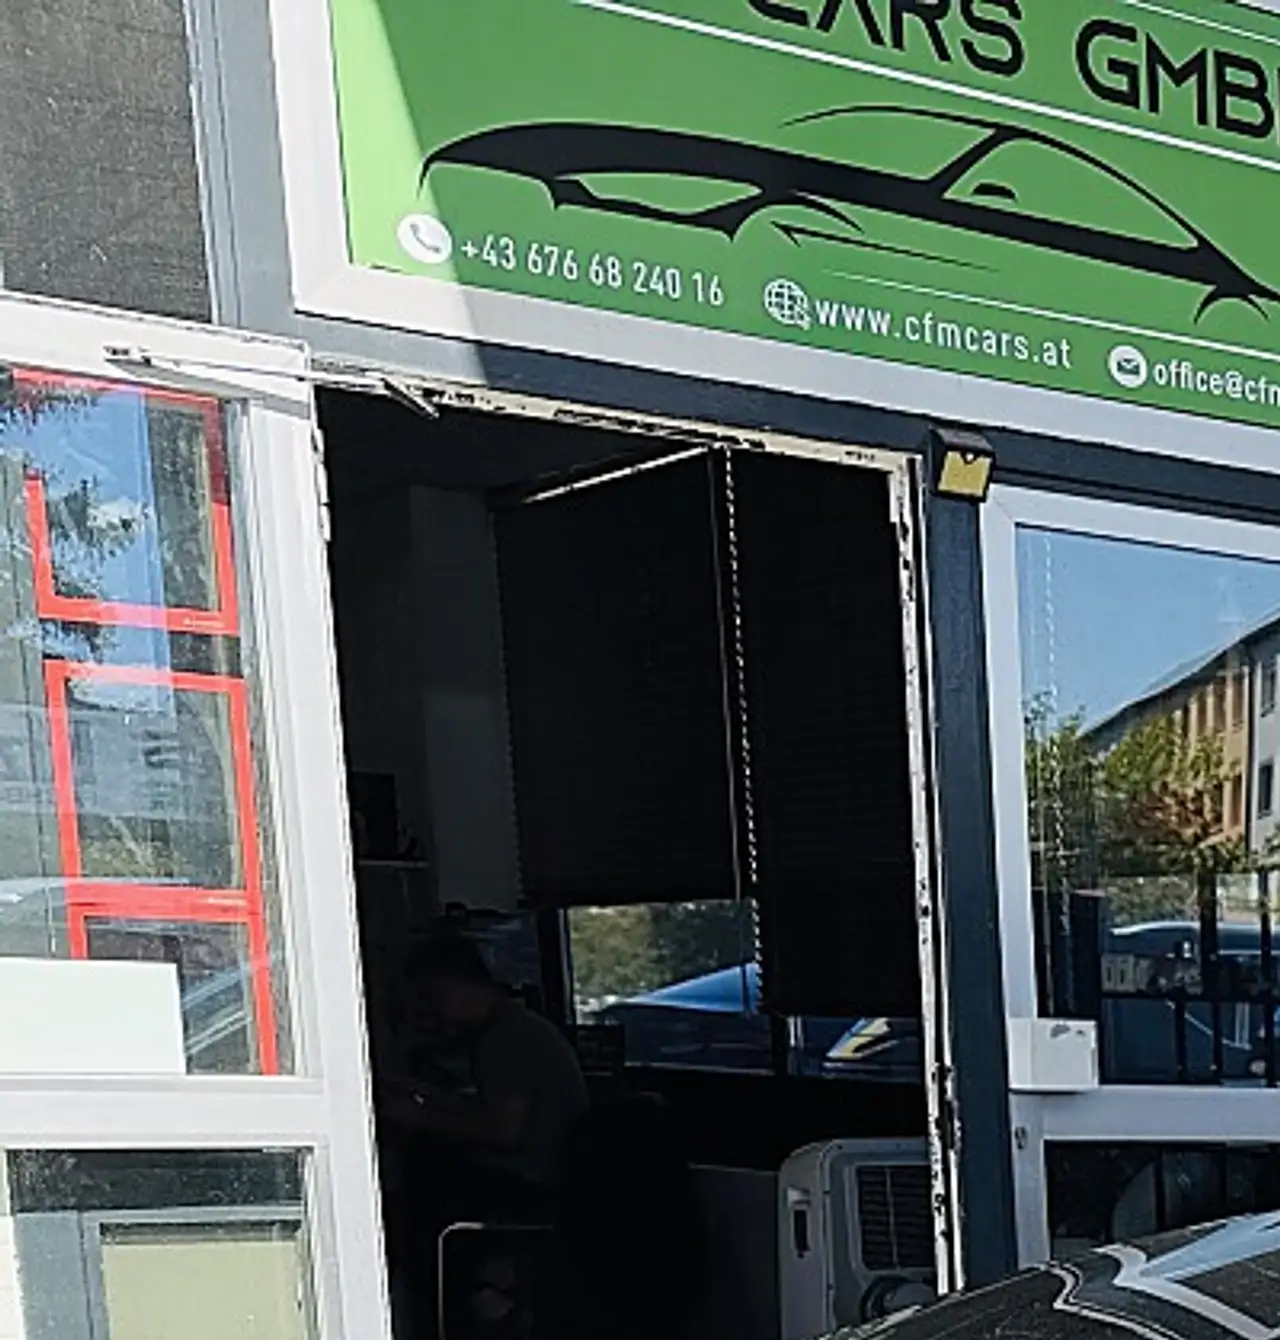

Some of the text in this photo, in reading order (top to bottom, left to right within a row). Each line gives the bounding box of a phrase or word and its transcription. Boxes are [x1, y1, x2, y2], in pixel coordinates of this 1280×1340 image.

[461, 234, 724, 306] +43 676 68 240 16
[816, 298, 1073, 370] www.cfmcars.at
